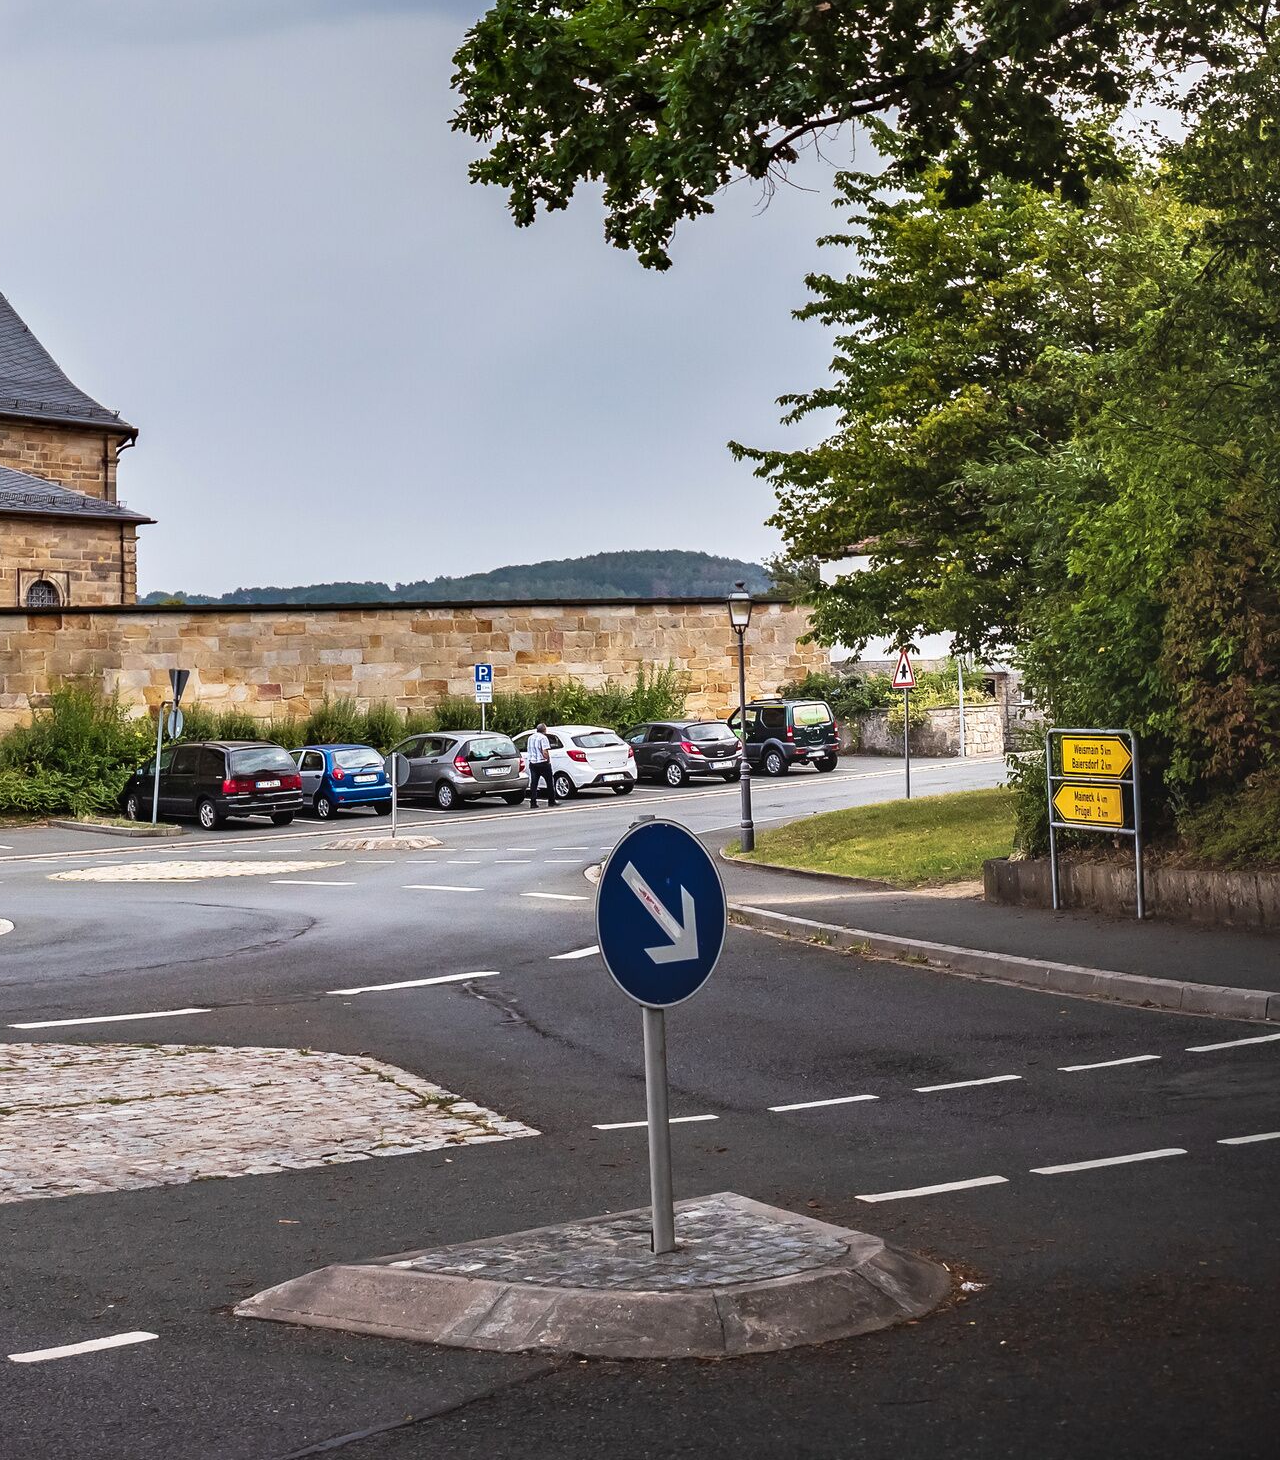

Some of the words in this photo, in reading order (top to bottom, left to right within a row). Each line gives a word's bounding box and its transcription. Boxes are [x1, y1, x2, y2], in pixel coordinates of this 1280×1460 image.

[478, 666, 488, 681] P
[1074, 744, 1098, 755] Weismain
[1100, 744, 1104, 755] 5
[1072, 757, 1098, 770] Baiersdorf
[1100, 759, 1104, 770] 2
[1105, 762, 1112, 771] km
[1074, 791, 1094, 802] Maineck
[1096, 792, 1100, 803] 4
[1074, 805, 1092, 819] Prügel
[1098, 806, 1100, 818] 2
[1102, 809, 1108, 818] km
